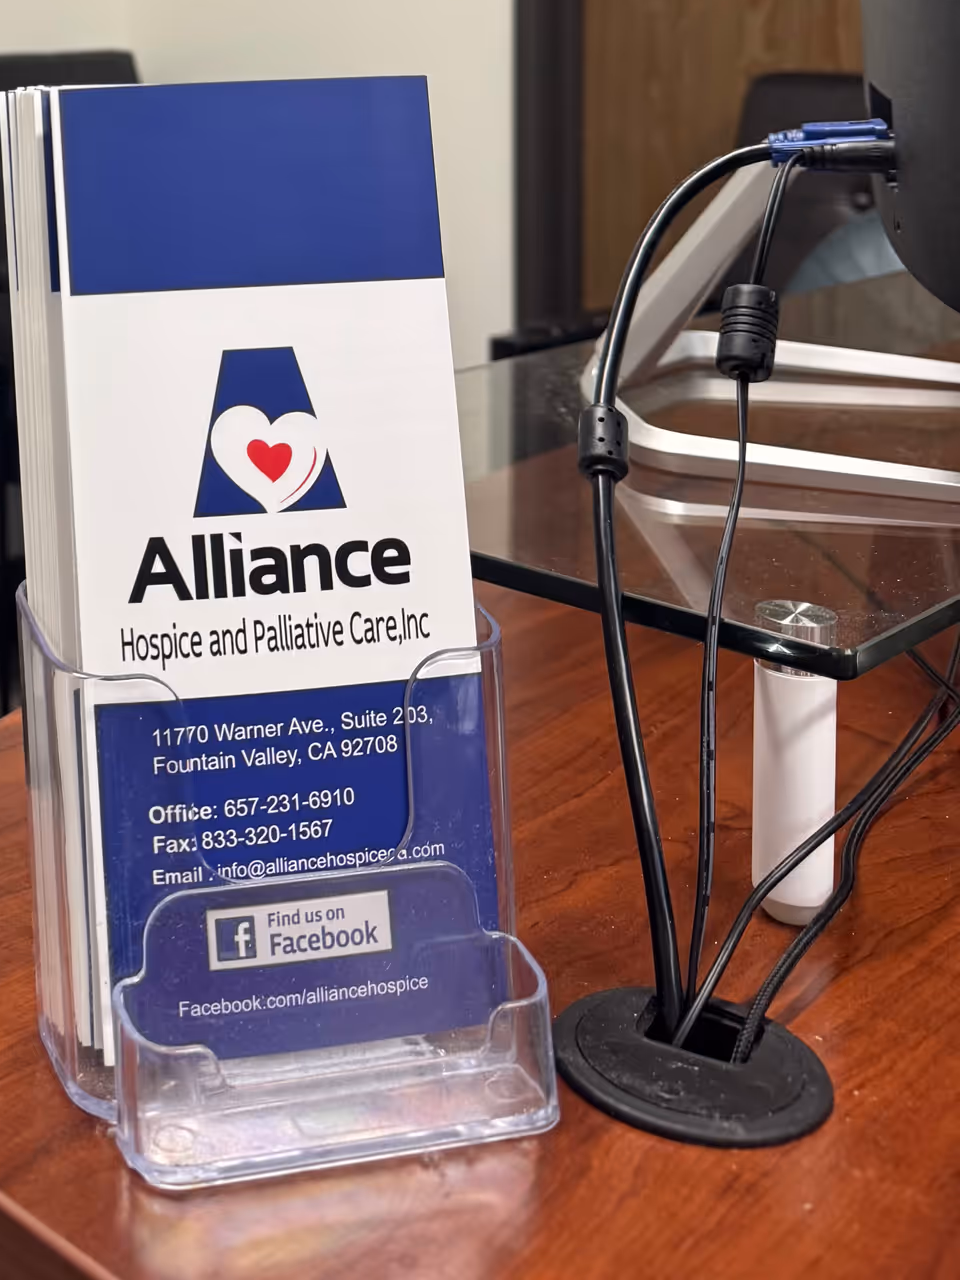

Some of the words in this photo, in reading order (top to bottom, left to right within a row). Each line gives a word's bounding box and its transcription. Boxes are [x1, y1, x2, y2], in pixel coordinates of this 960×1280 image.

[128, 531, 412, 604] Alliance
[121, 622, 202, 670] Hospice
[209, 618, 247, 656] and
[253, 612, 344, 653] Palliative
[152, 725, 208, 747] 11770
[214, 722, 284, 742] Warner
[288, 717, 335, 736] Ave.,
[341, 710, 387, 730] Suite
[153, 751, 236, 775] Fountain
[241, 746, 302, 767] Valley,
[308, 741, 337, 761] CA
[340, 734, 398, 758] 92708
[148, 803, 218, 825] Office:
[223, 787, 355, 818] 657-231-6910
[153, 835, 198, 854] Fax:
[202, 818, 333, 851] 833-320-1567
[152, 866, 203, 886] Email
[268, 909, 300, 928] Find
[305, 911, 322, 923] us
[326, 907, 345, 920] on
[269, 920, 379, 956] Facebook
[178, 975, 429, 1017] Facebook.com/alliancehospice
